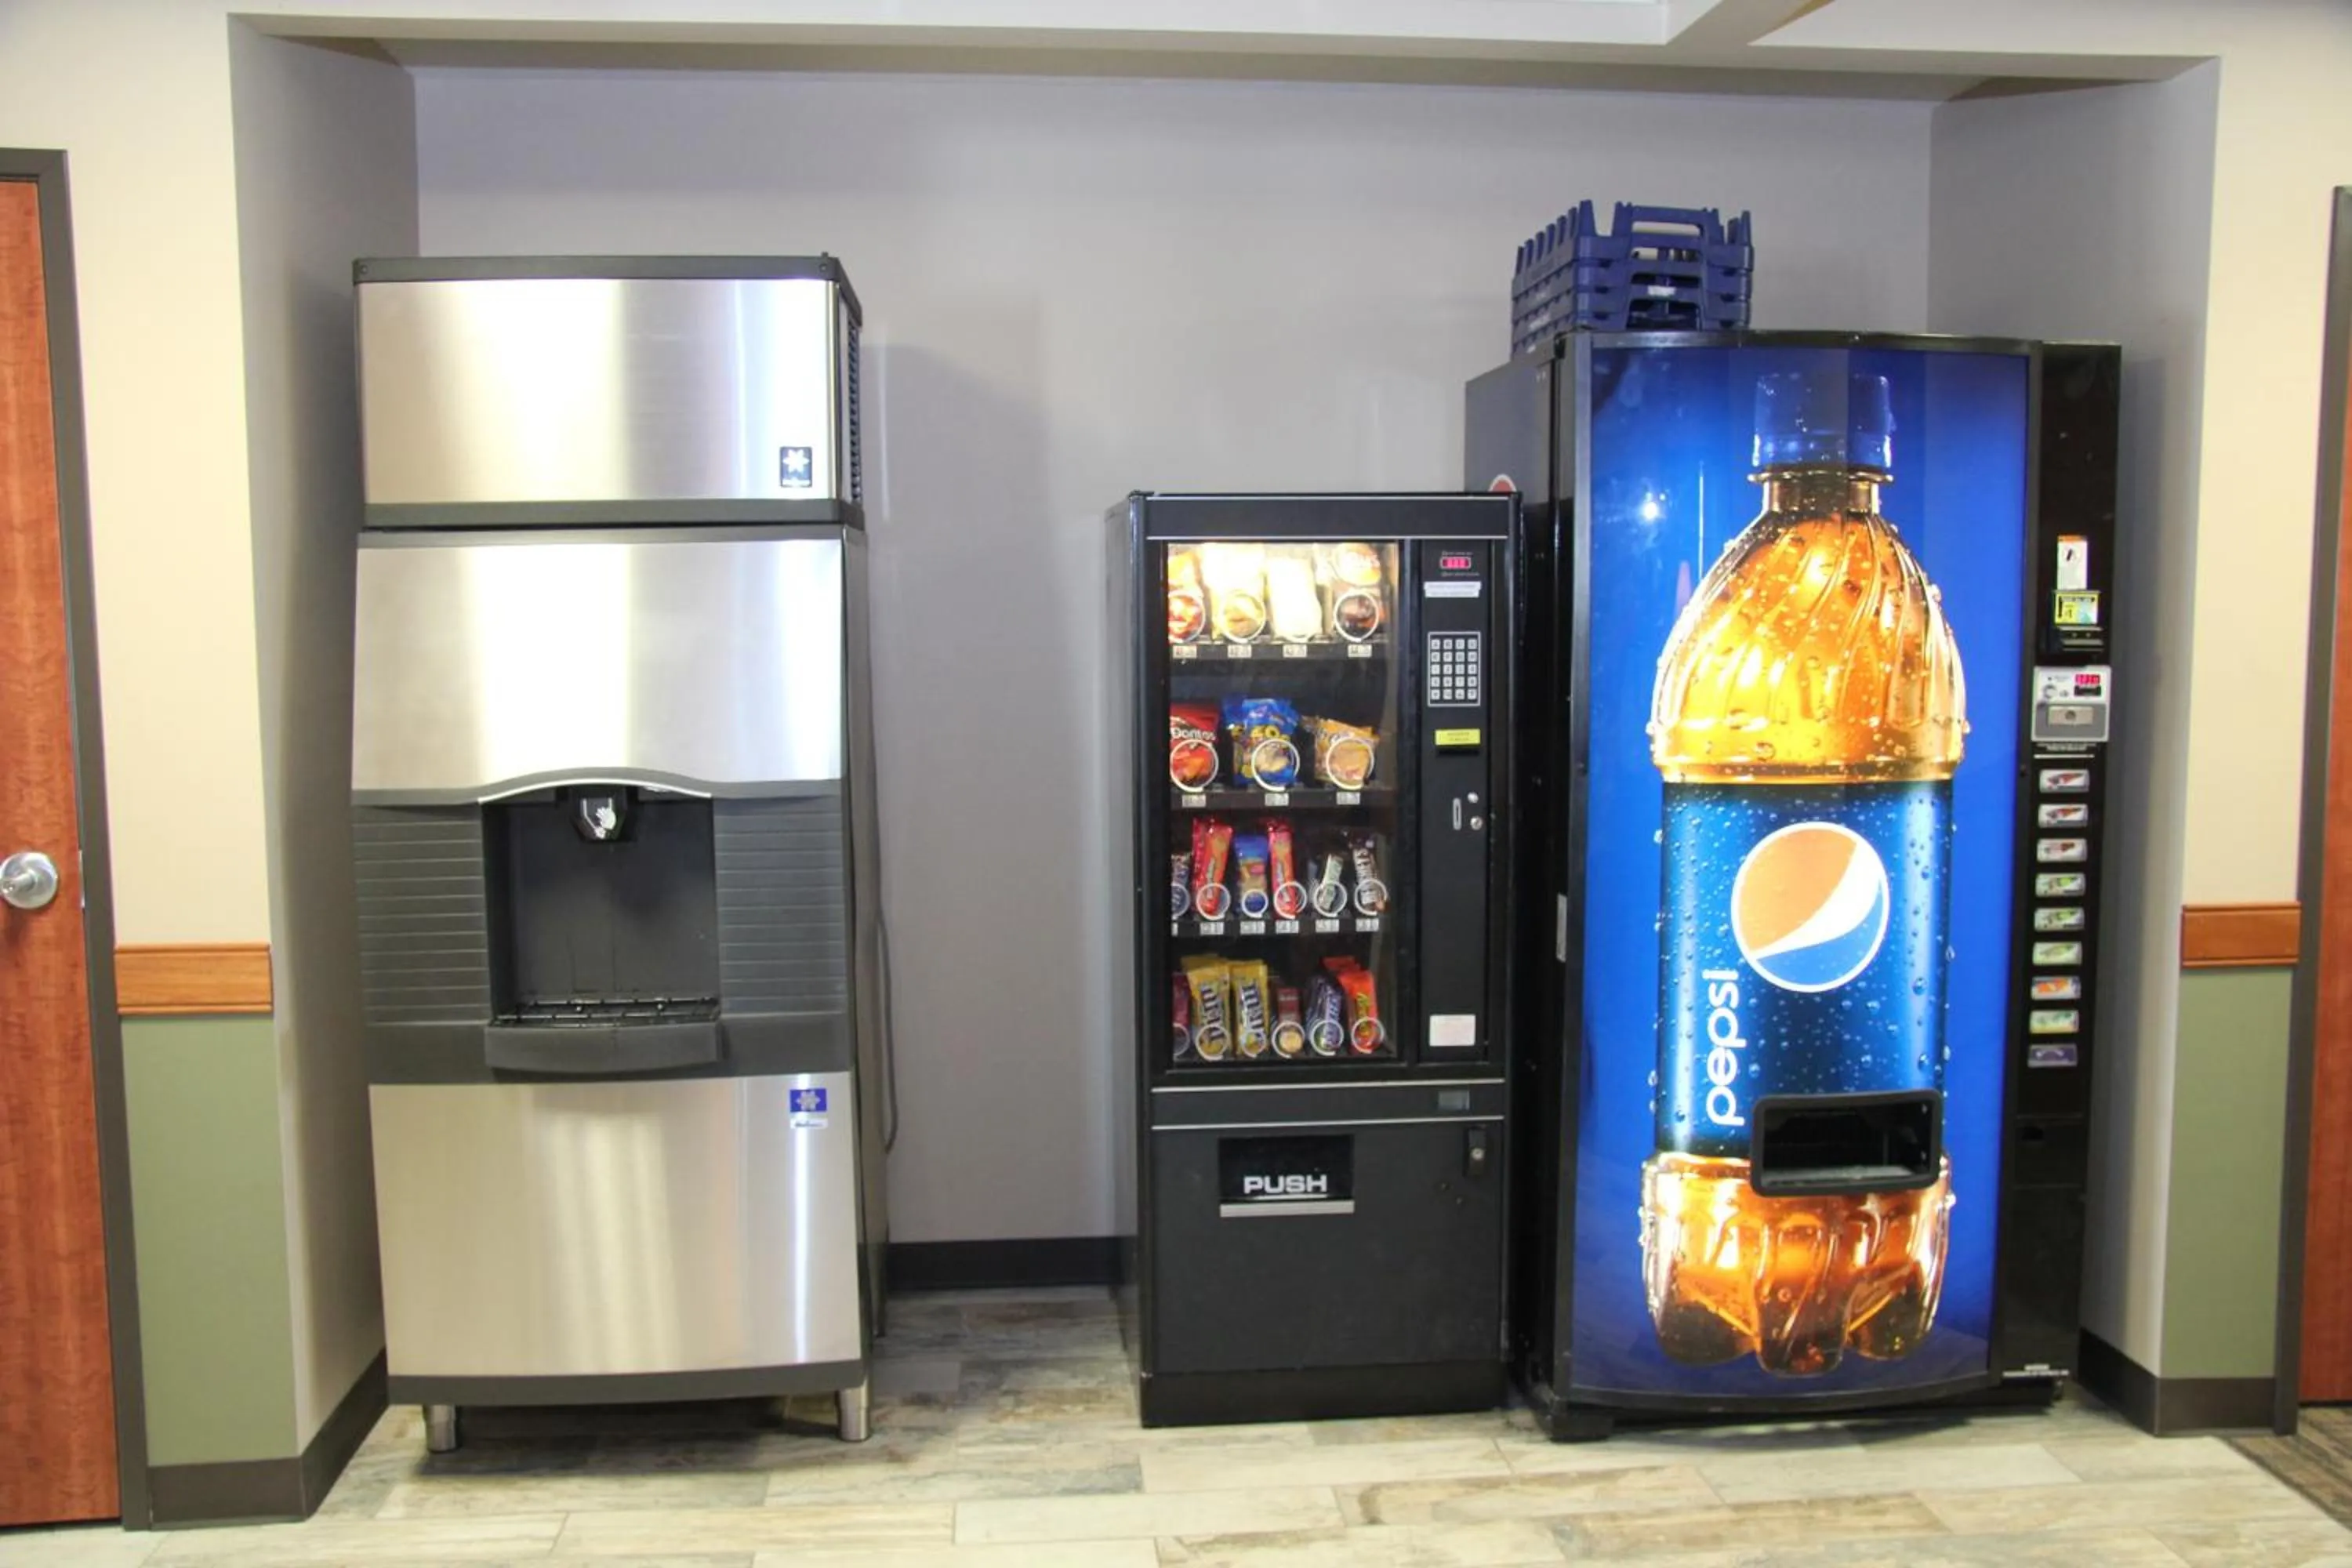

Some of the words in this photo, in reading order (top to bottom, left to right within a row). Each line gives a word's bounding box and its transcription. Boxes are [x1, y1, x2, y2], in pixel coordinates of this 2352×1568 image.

[1170, 727, 1217, 741] Doritos
[1702, 969, 1746, 1126] pepsi
[1243, 1174, 1327, 1194] PUSH
